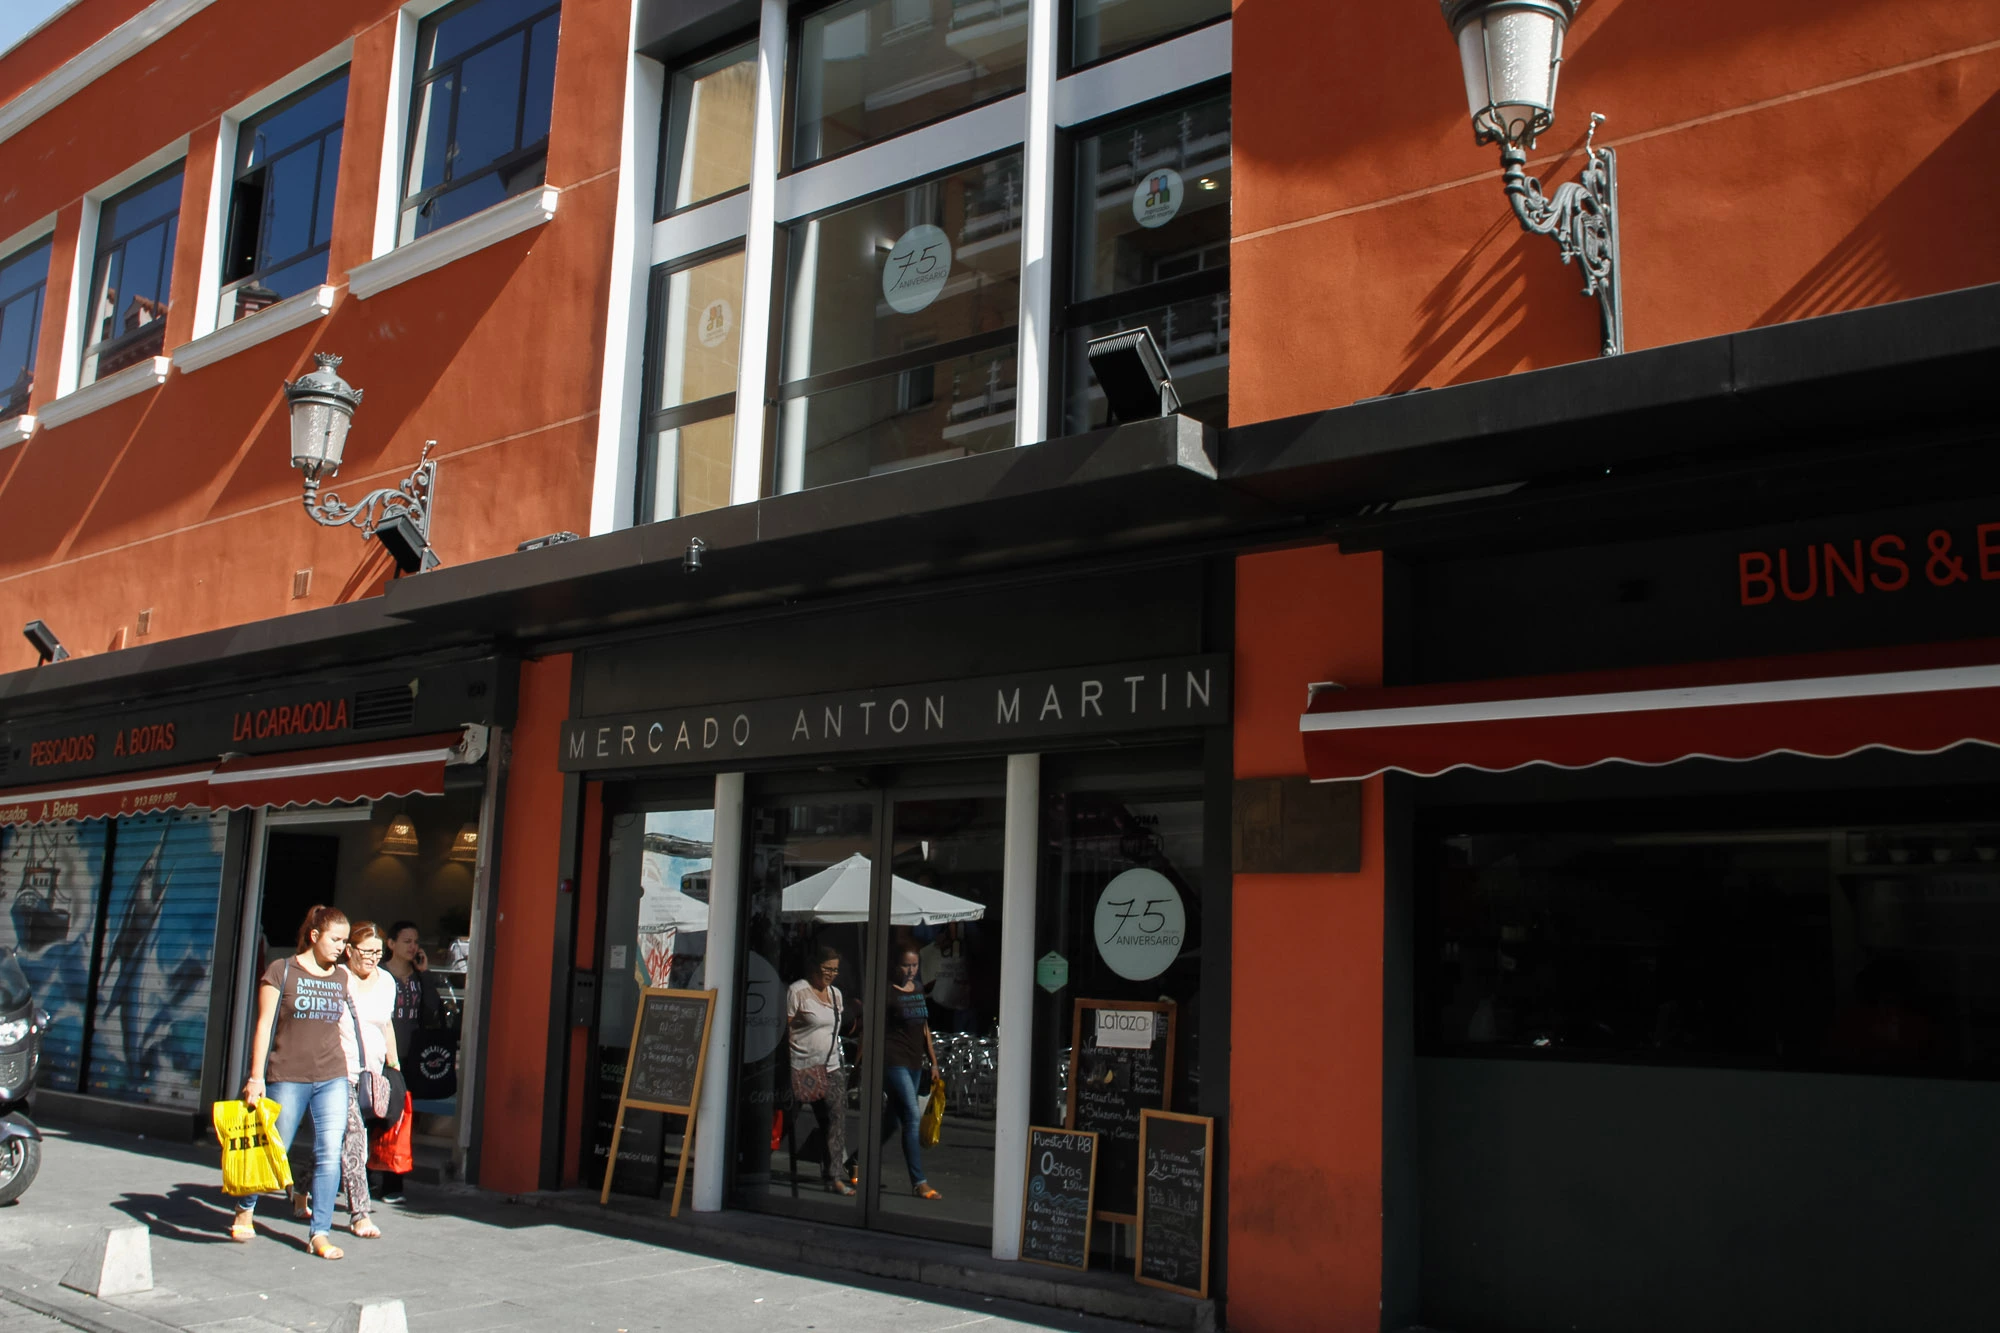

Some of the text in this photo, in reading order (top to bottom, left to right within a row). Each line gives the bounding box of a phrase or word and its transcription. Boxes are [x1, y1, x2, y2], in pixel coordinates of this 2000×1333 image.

[889, 242, 943, 292] 75
[899, 270, 948, 290] ANIVERSARIO
[233, 699, 348, 742] LA CARACOLA
[567, 669, 1212, 760] MERCADO ANTON MARTIN
[30, 722, 175, 767] PESCADOS A. BOTAS
[40, 803, 51, 819] A.
[52, 801, 79, 818] Botas
[1103, 898, 1173, 945] 75
[1115, 935, 1181, 947] ANIVERSARIO
[296, 986, 318, 997] Boys
[297, 977, 343, 991] ANYTHING
[294, 995, 345, 1013] GIRLS
[293, 1011, 307, 1019] do
[229, 1133, 270, 1152] IRIS
[1033, 1132, 1063, 1149] Puesto
[1041, 1151, 1083, 1181] Ostras
